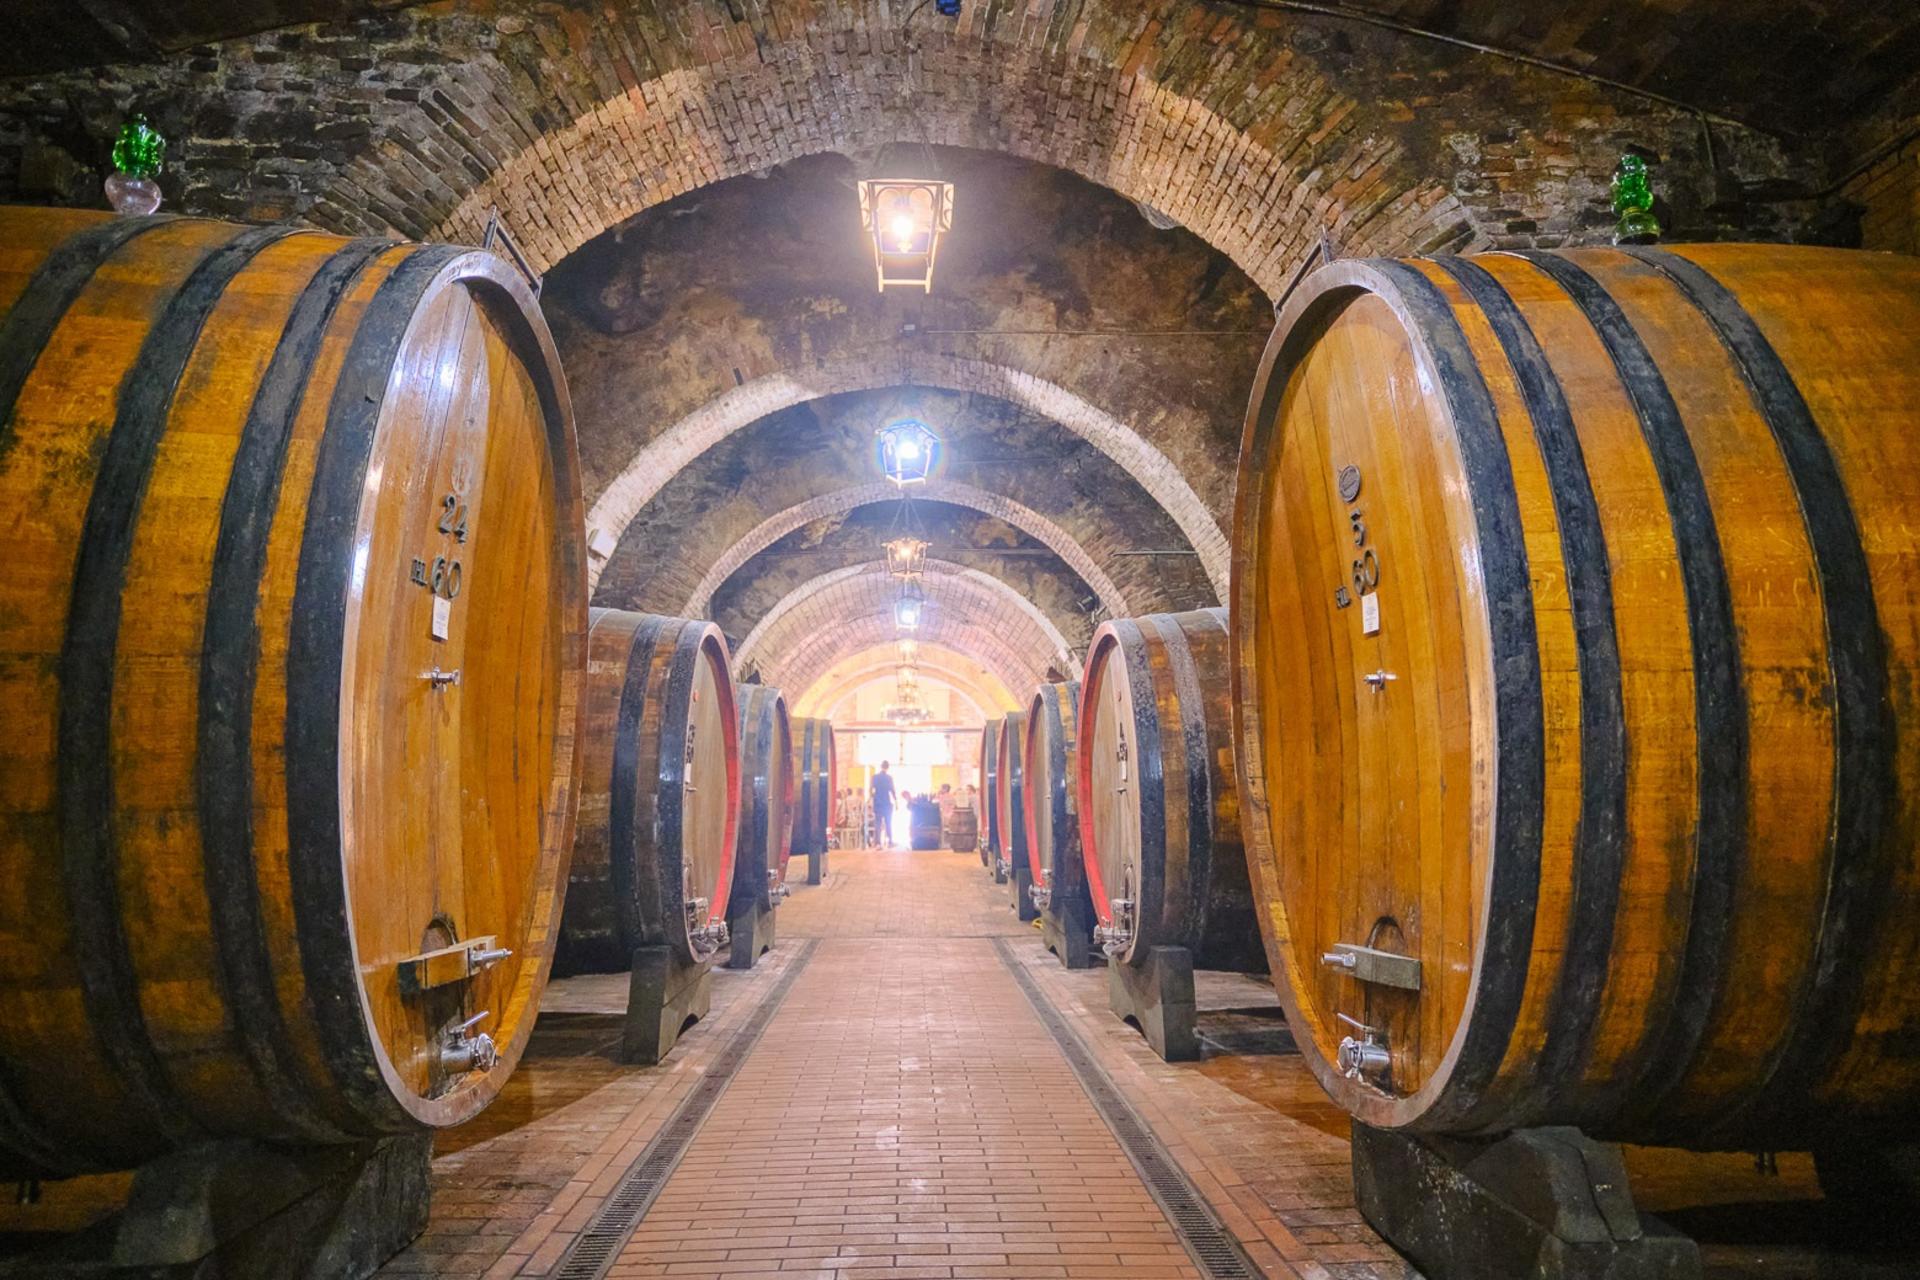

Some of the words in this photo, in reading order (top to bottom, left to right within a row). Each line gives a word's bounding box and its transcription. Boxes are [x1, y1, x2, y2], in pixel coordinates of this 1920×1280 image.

[438, 494, 468, 543] 24
[431, 555, 462, 598] 60
[1352, 549, 1380, 597] 60
